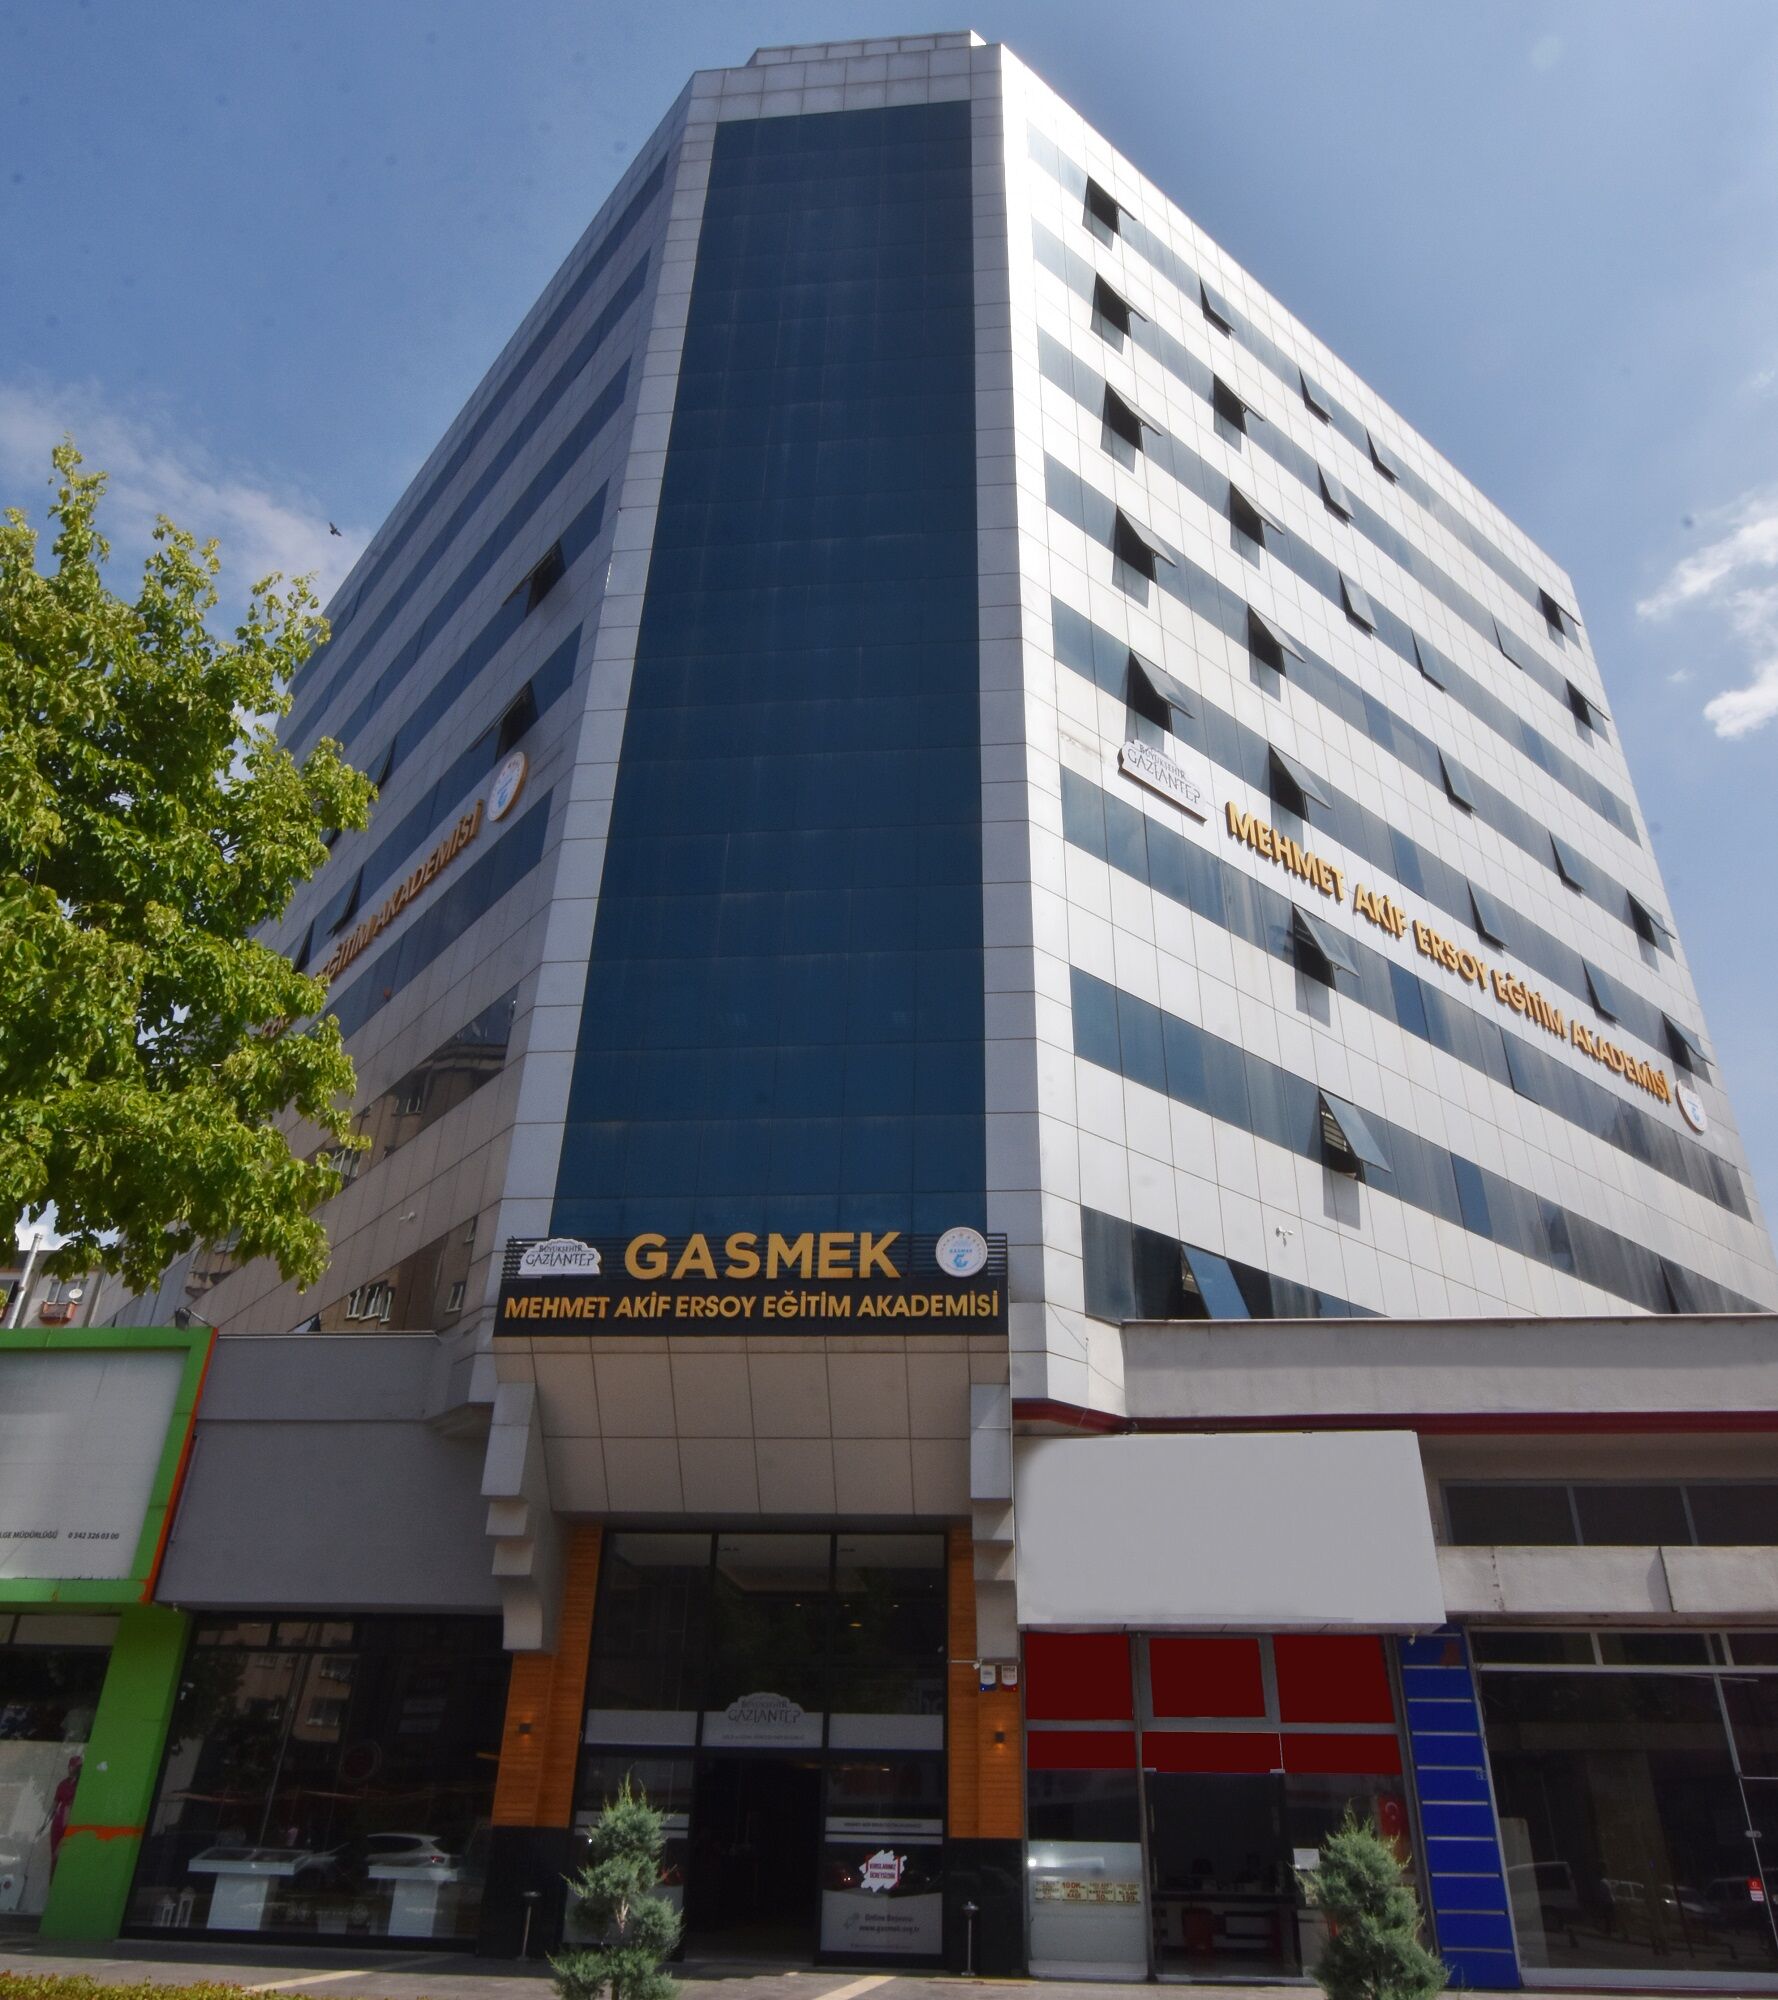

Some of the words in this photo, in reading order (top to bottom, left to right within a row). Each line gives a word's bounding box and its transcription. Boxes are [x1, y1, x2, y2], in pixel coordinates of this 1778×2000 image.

[1225, 801, 1345, 902] MEHMET
[1353, 883, 1408, 938] AKİF
[1412, 919, 1488, 990] ERSOY
[1491, 969, 1568, 1039] EĞİTİM
[1570, 1019, 1672, 1104] AKADEMİSİ
[624, 1232, 902, 1280] GASMEK
[504, 1296, 610, 1319] MEHMET
[614, 1291, 672, 1319] AKİF
[675, 1295, 757, 1318] ERSOY
[763, 1290, 851, 1318] EĞİTİM
[857, 1290, 999, 1318] AKADEMİSİ
